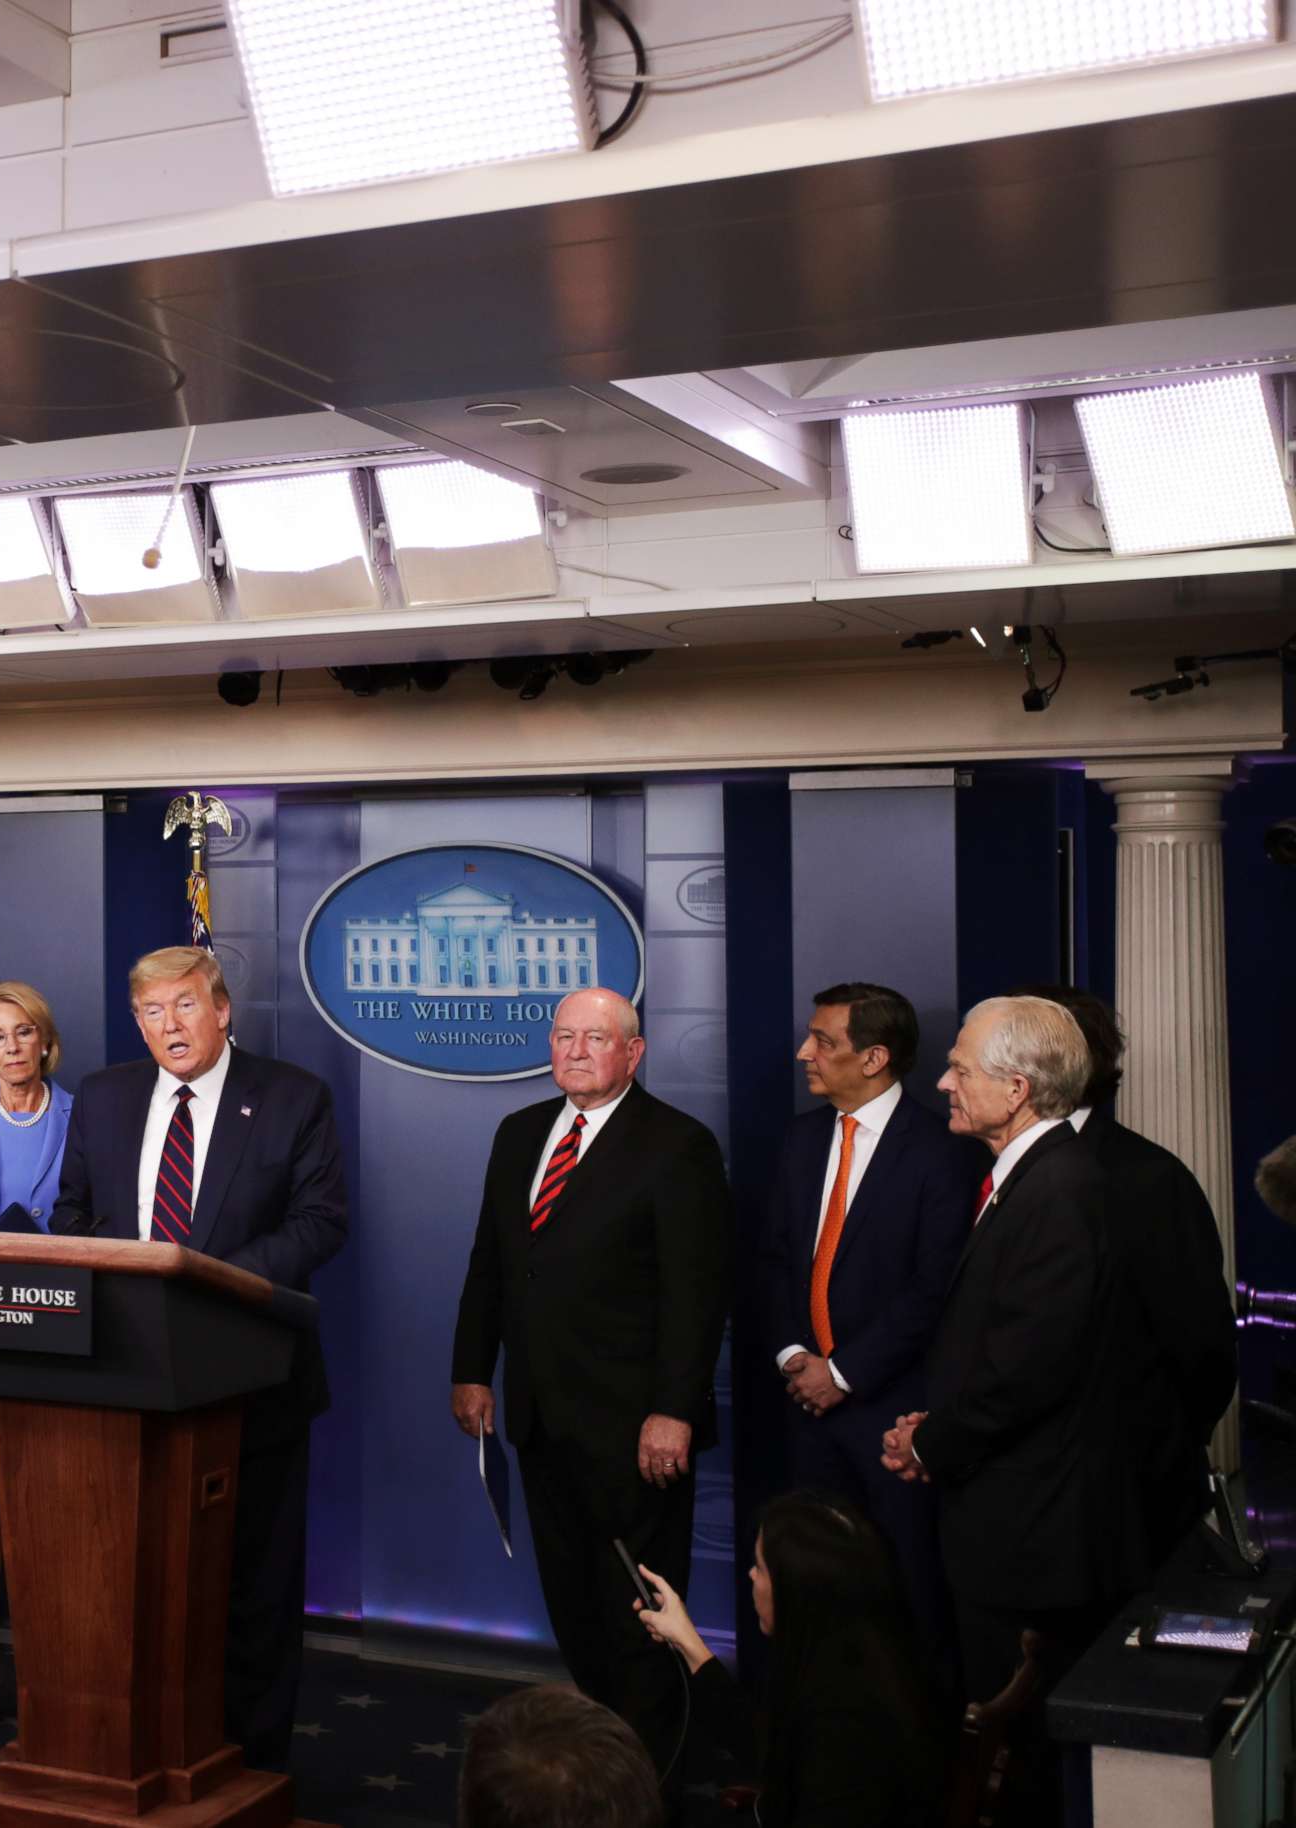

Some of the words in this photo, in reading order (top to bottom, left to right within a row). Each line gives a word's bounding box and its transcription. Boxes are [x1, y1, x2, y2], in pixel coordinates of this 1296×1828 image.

[353, 1000, 401, 1019] THE
[410, 1002, 494, 1021] WHITE
[506, 1003, 554, 1022] HOU
[415, 1031, 528, 1046] WASHINGTON
[11, 1287, 76, 1307] HOUSE
